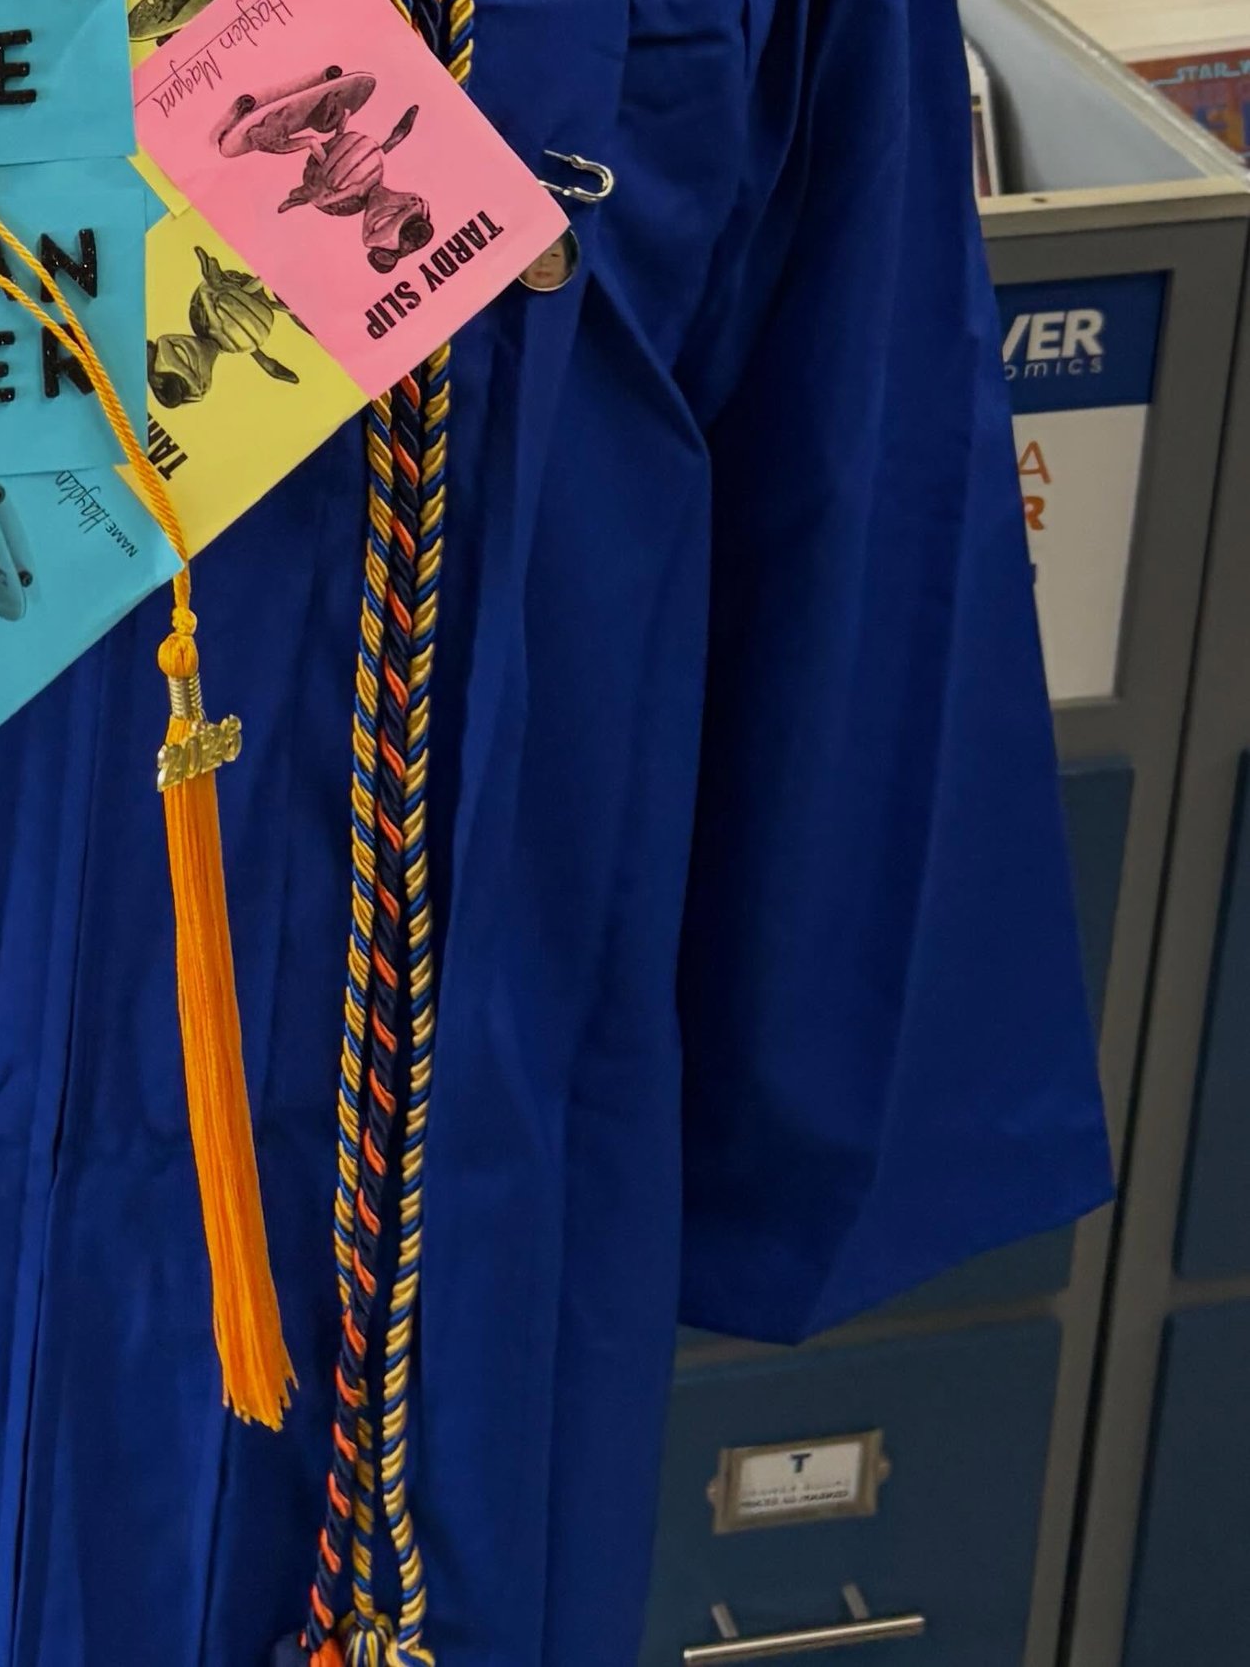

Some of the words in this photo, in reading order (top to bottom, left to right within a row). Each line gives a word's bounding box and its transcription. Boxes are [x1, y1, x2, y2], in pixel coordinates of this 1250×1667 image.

[1148, 62, 1240, 89] STAR
[424, 210, 505, 292] TARDY
[364, 281, 423, 340] SLIP
[1002, 308, 1104, 363] VER
[1004, 358, 1103, 381] omics
[104, 519, 139, 559] NAME:
